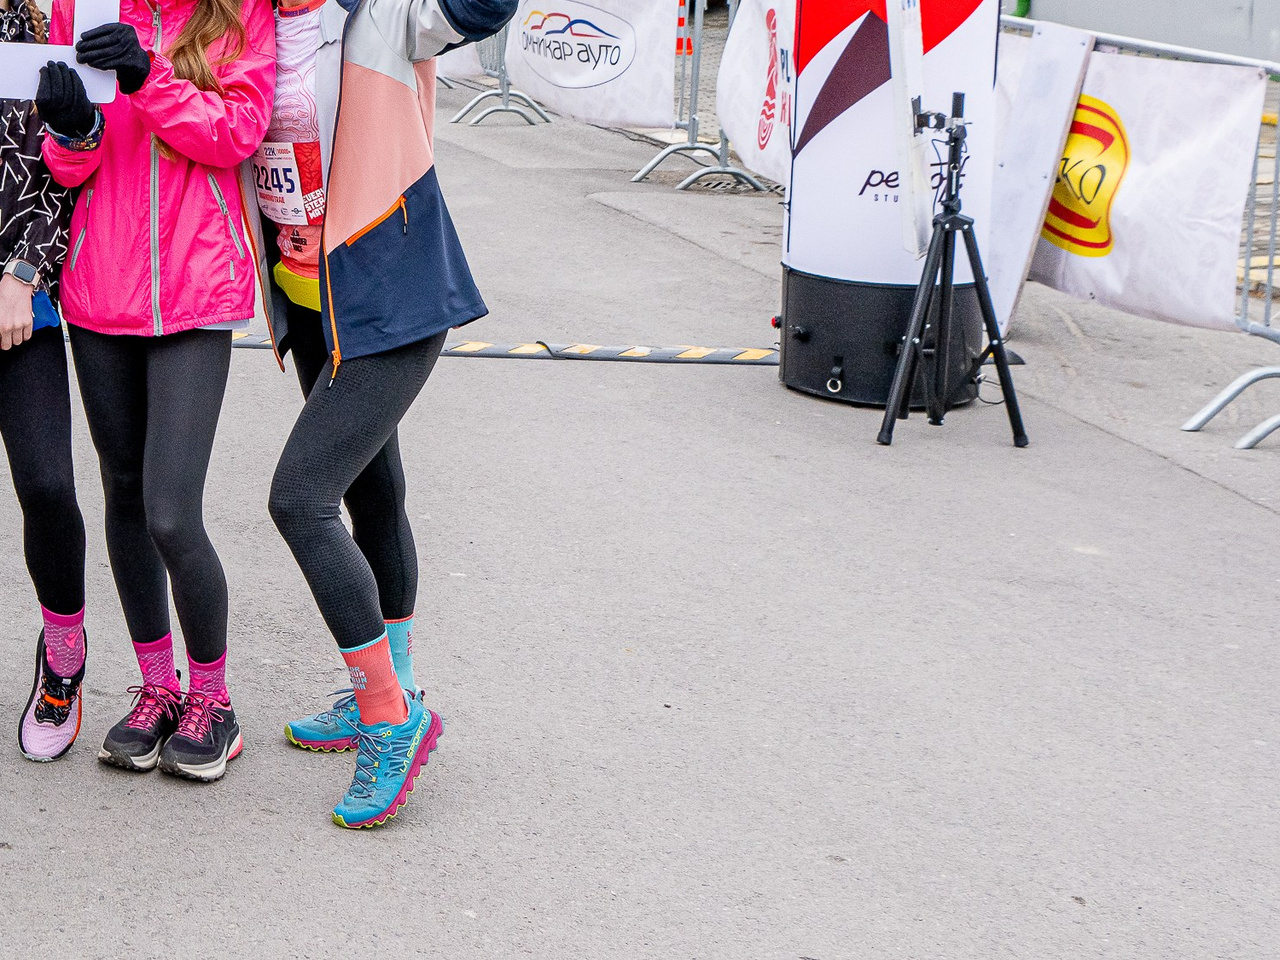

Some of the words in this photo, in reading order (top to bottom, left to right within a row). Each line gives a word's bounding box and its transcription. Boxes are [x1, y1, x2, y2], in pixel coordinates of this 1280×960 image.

[254, 163, 296, 194] 2245
[873, 193, 900, 204] STU
[399, 759, 411, 774] LA
[406, 709, 430, 759] SPORTIVA
